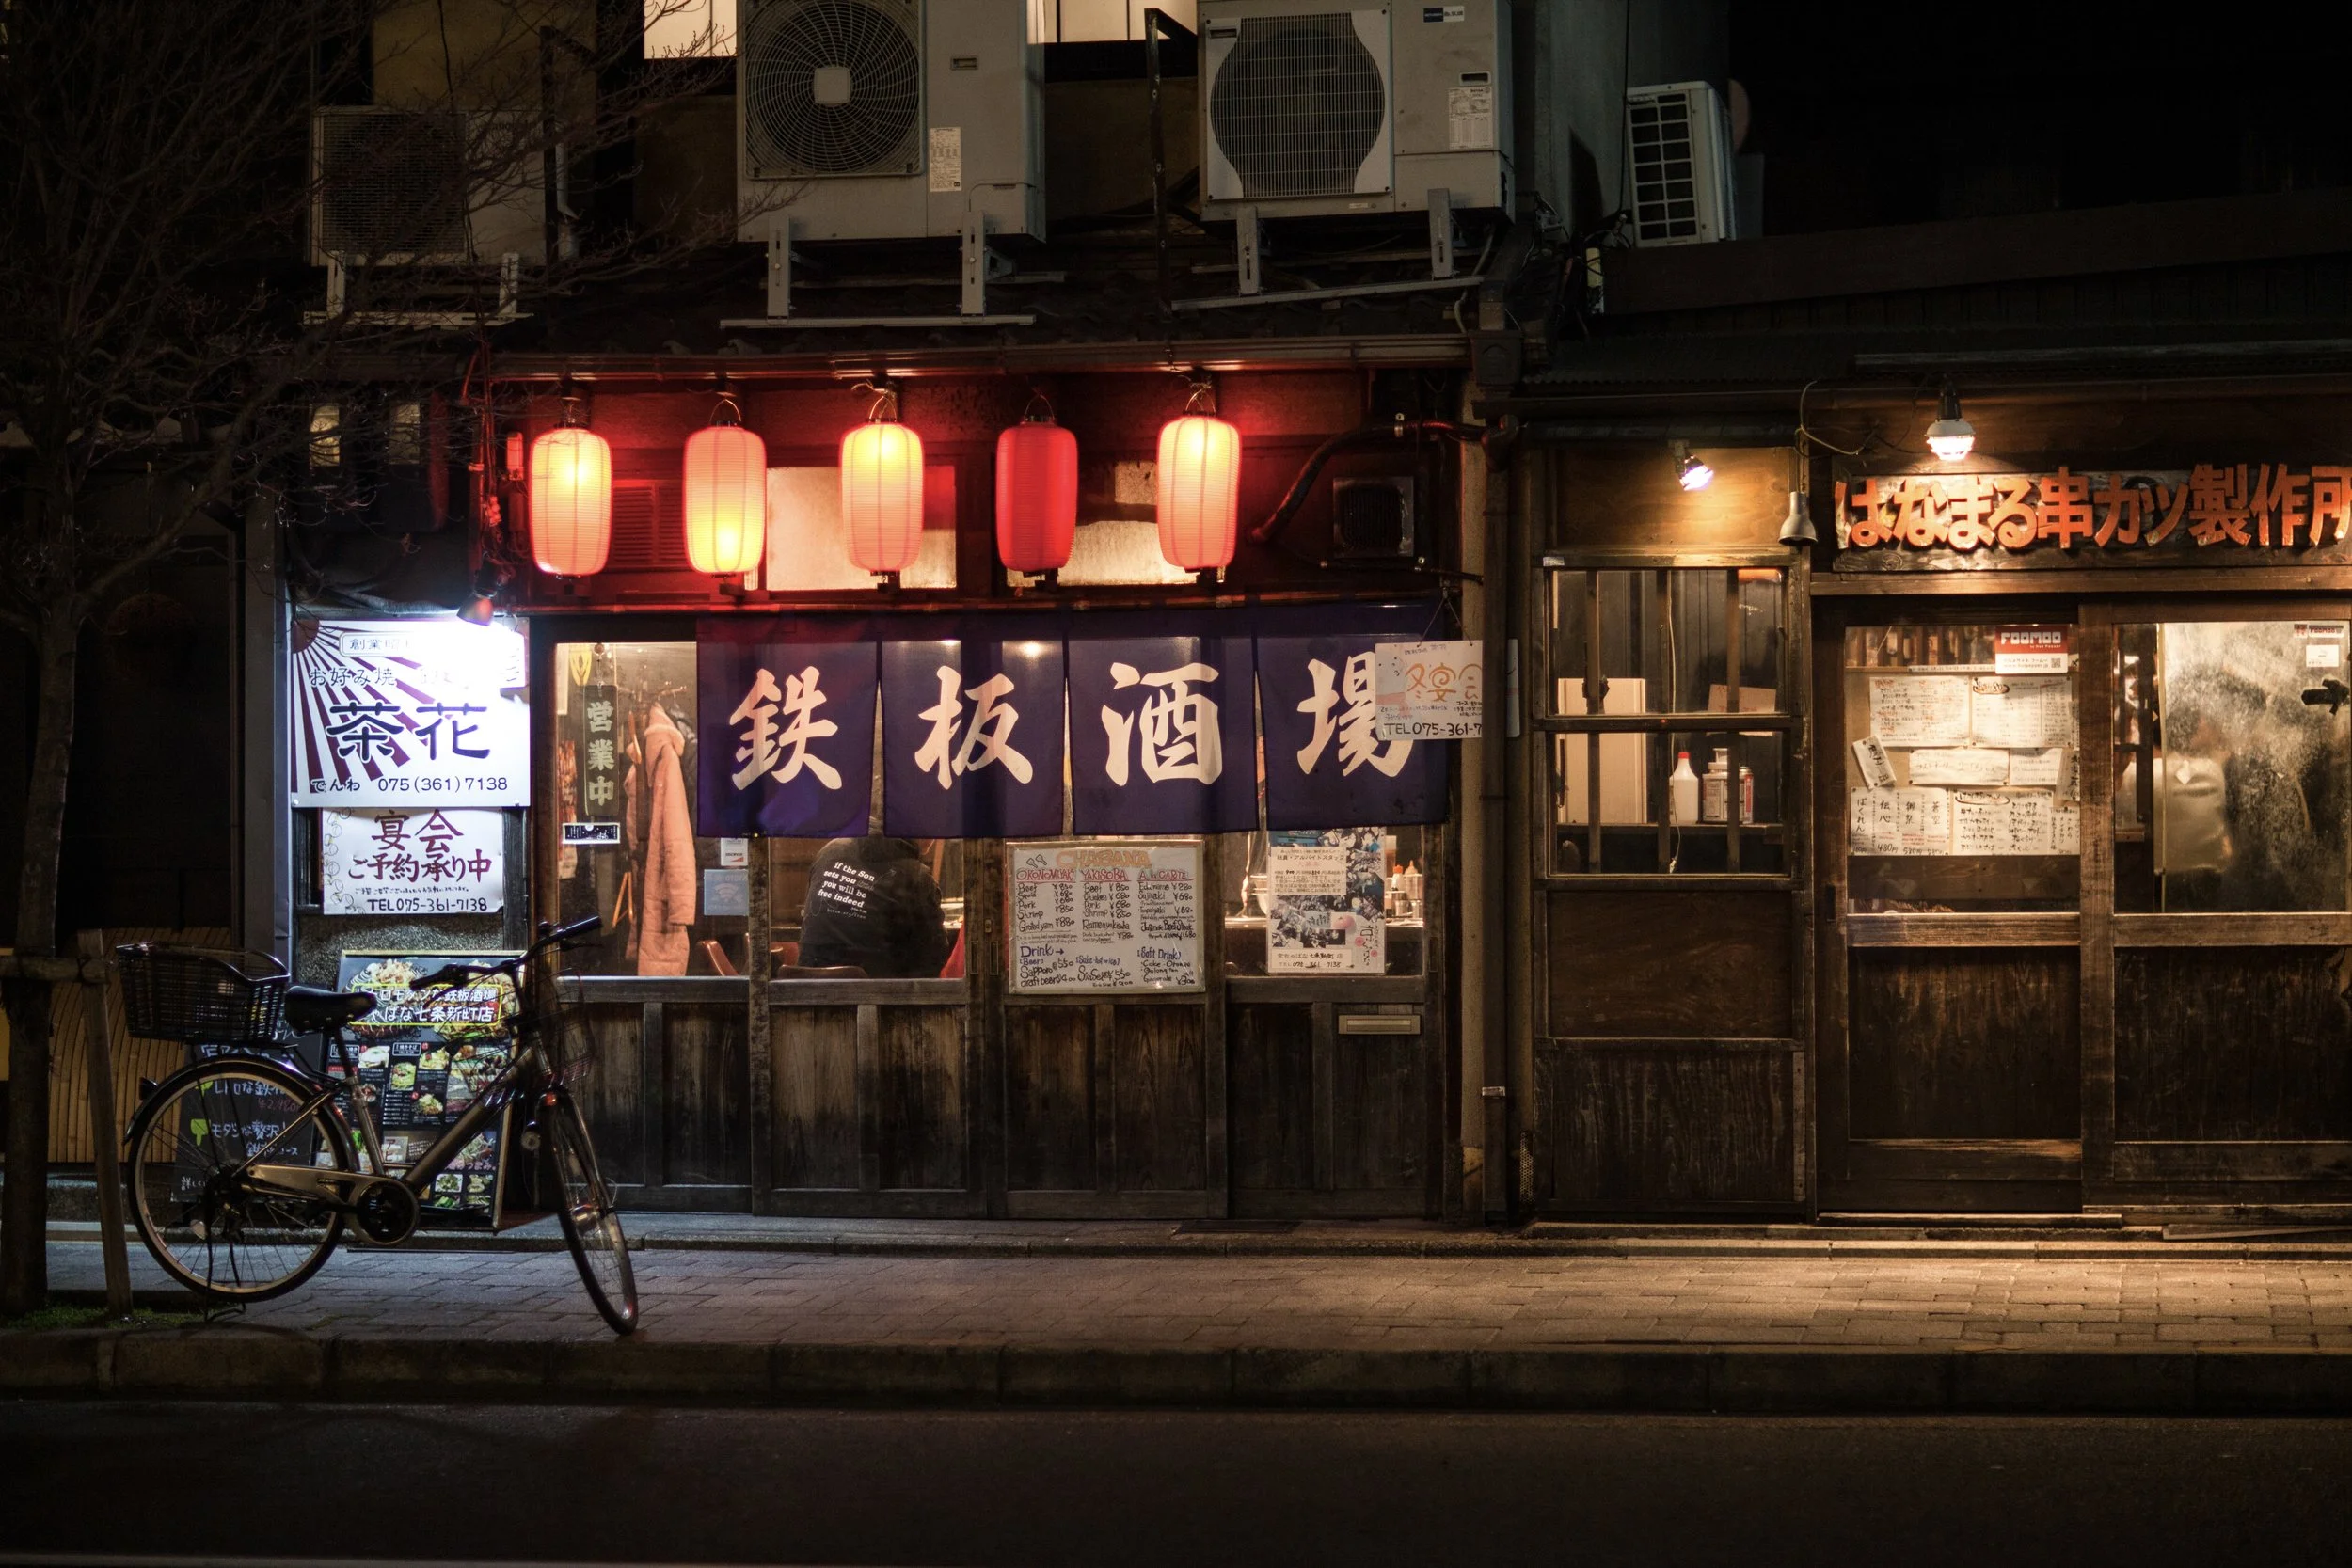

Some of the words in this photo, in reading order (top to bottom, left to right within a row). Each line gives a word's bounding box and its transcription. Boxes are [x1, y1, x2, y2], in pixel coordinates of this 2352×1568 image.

[1834, 464, 2352, 550] はなまる串カツ製作所
[2001, 632, 2061, 645] FOOMOO
[326, 702, 491, 762] 茶花
[729, 653, 1417, 790] 鉄板酒場
[587, 701, 614, 806] 営業中
[310, 778, 361, 793] でんわ
[371, 809, 464, 852] 宴会
[348, 848, 493, 883] ご予約承り中
[823, 870, 840, 879] sets
[839, 875, 857, 884] you
[842, 865, 857, 875] the
[858, 870, 875, 882] Son
[818, 888, 833, 898] free
[834, 893, 864, 907] indeed
[821, 880, 837, 890] you
[838, 884, 855, 895] will
[855, 889, 867, 898] be
